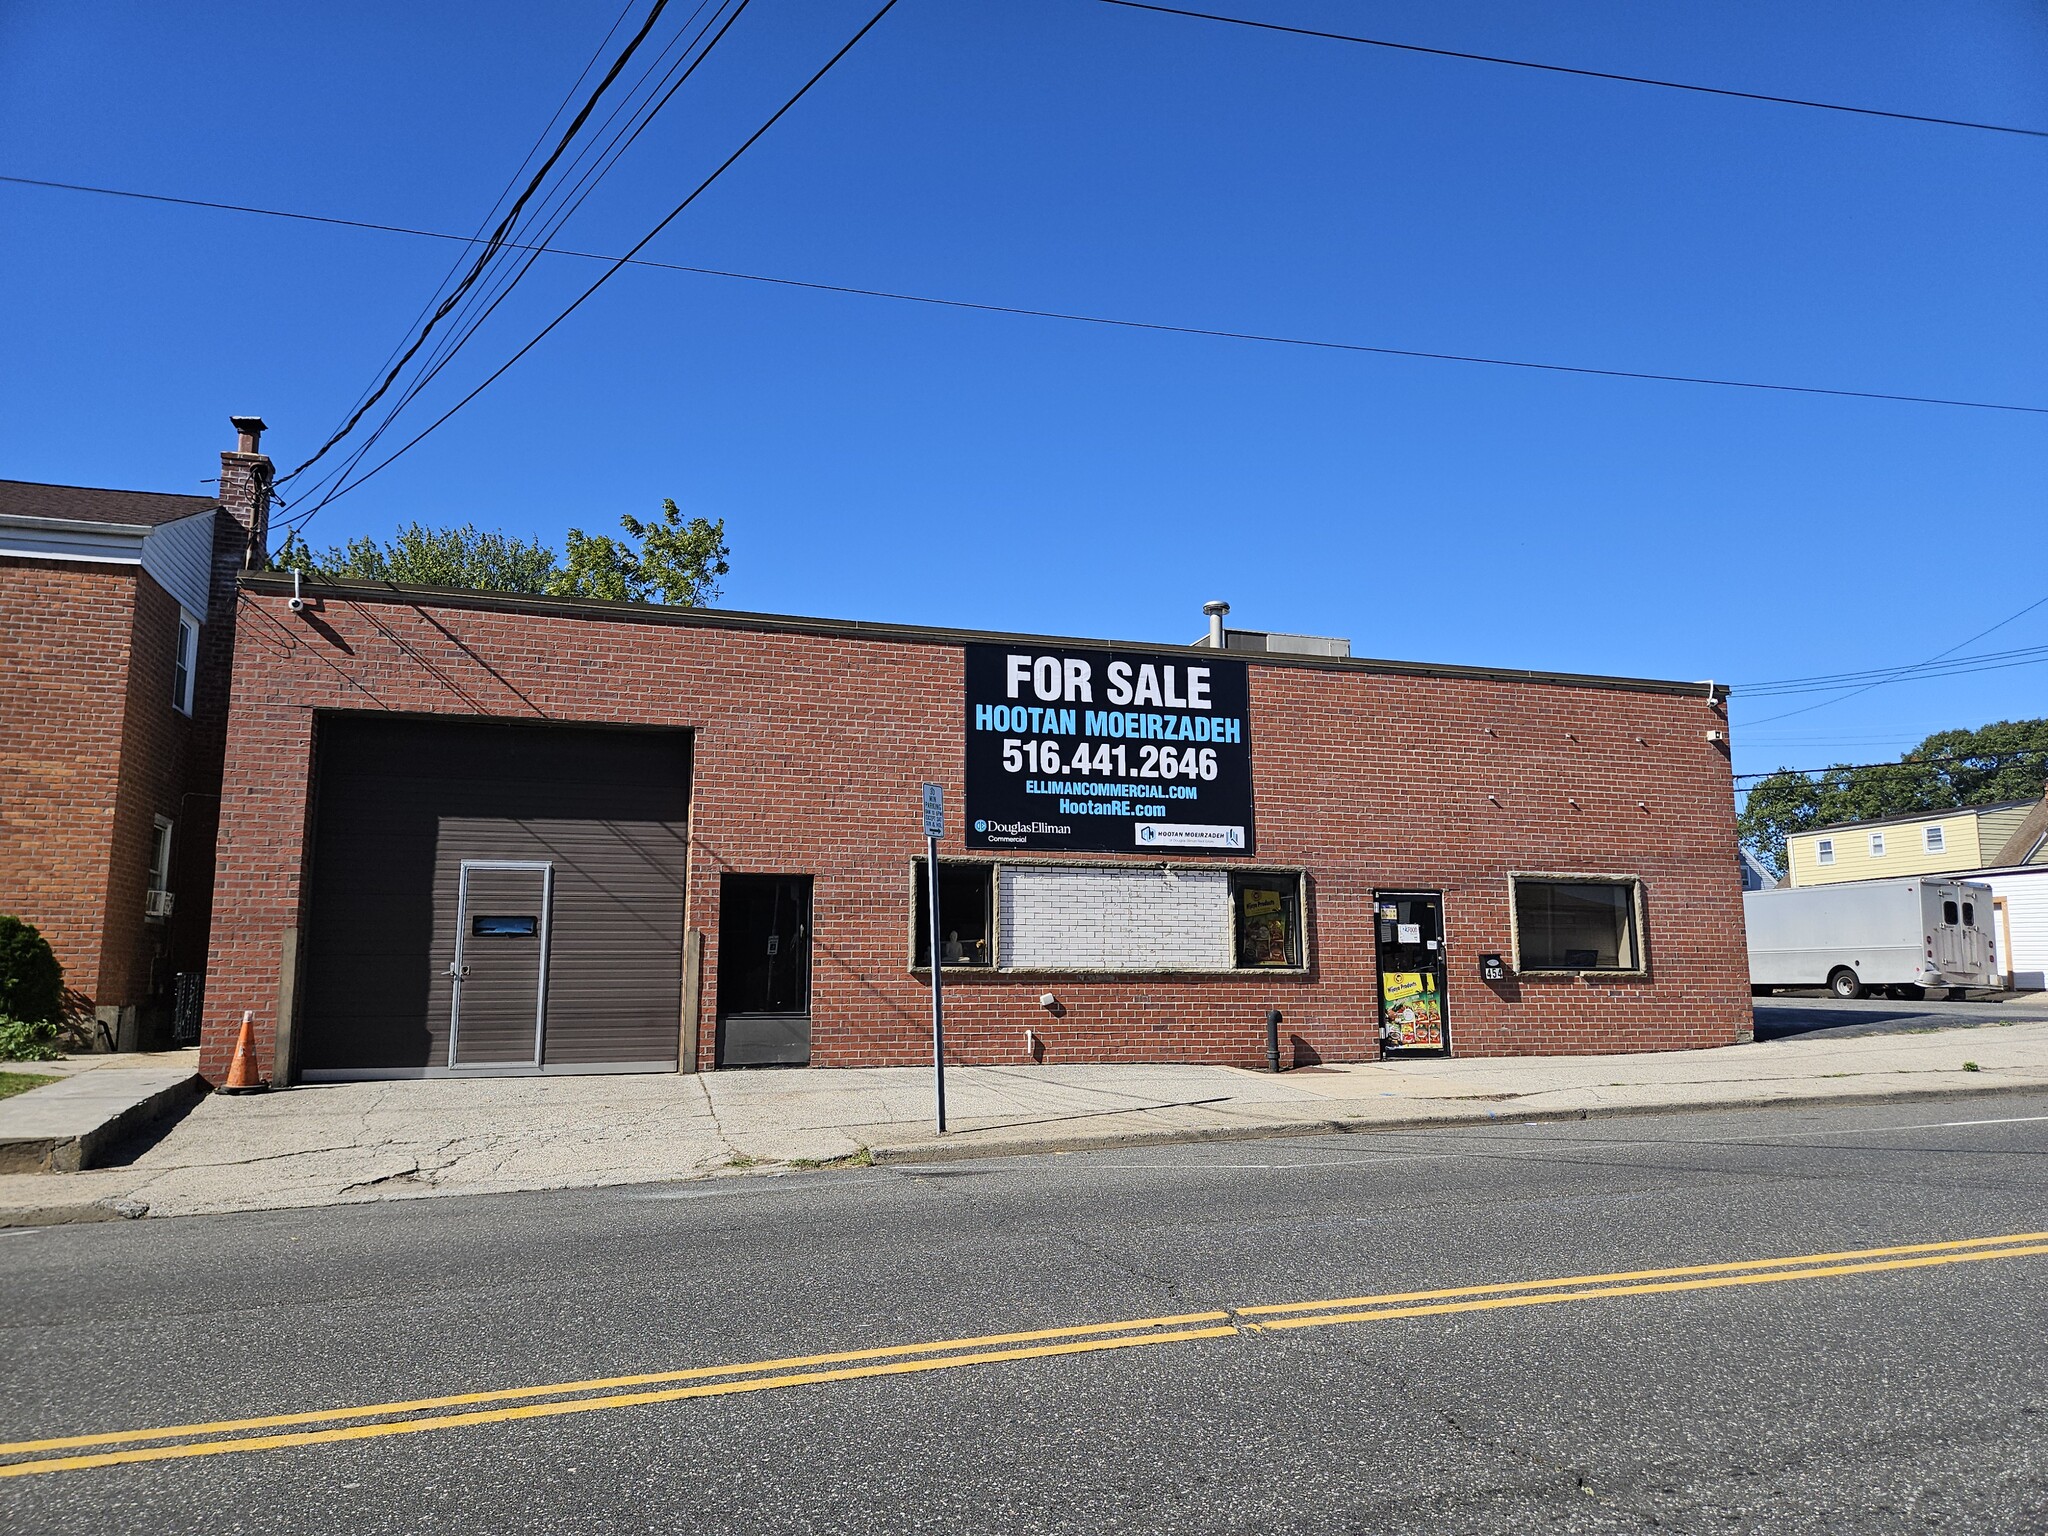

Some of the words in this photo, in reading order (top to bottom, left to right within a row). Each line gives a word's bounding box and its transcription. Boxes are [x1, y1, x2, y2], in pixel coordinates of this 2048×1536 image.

[1007, 654, 1093, 703] FOR
[1107, 661, 1212, 709] SALE
[976, 704, 1076, 735] HOOTAN
[1085, 710, 1240, 743] MOEIRZADEH
[1002, 738, 1218, 781] 516.441.2646
[1026, 780, 1197, 800] ELLIMANCOMMERCIAL.COM
[926, 802, 941, 810] PARKING
[1060, 799, 1166, 817] HootanRE.com
[988, 835, 1027, 843] Commercial
[1487, 968, 1502, 979] 454
[1400, 982, 1417, 990] Products
